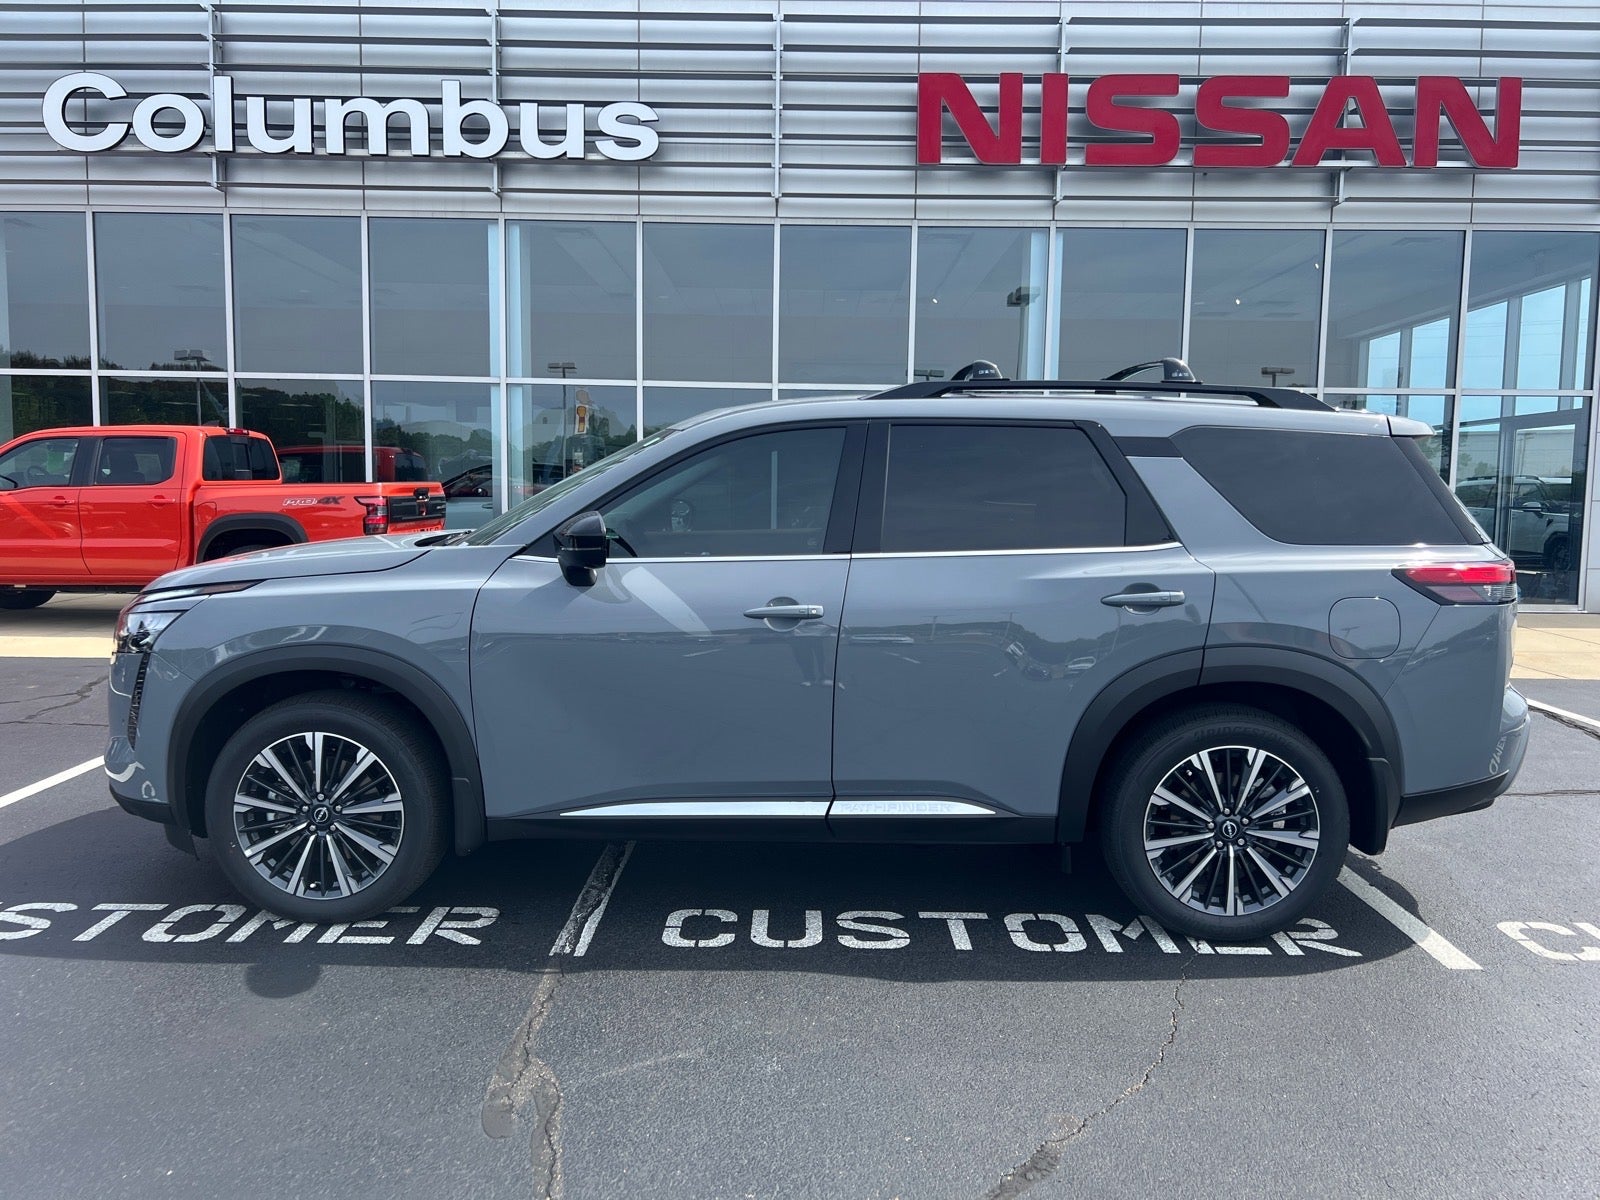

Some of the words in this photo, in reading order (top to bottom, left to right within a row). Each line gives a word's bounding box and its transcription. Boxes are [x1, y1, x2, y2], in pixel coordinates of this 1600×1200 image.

[42, 71, 661, 162] Columbus
[917, 72, 1523, 169] NISSAN
[840, 802, 952, 813] PATHFINDER
